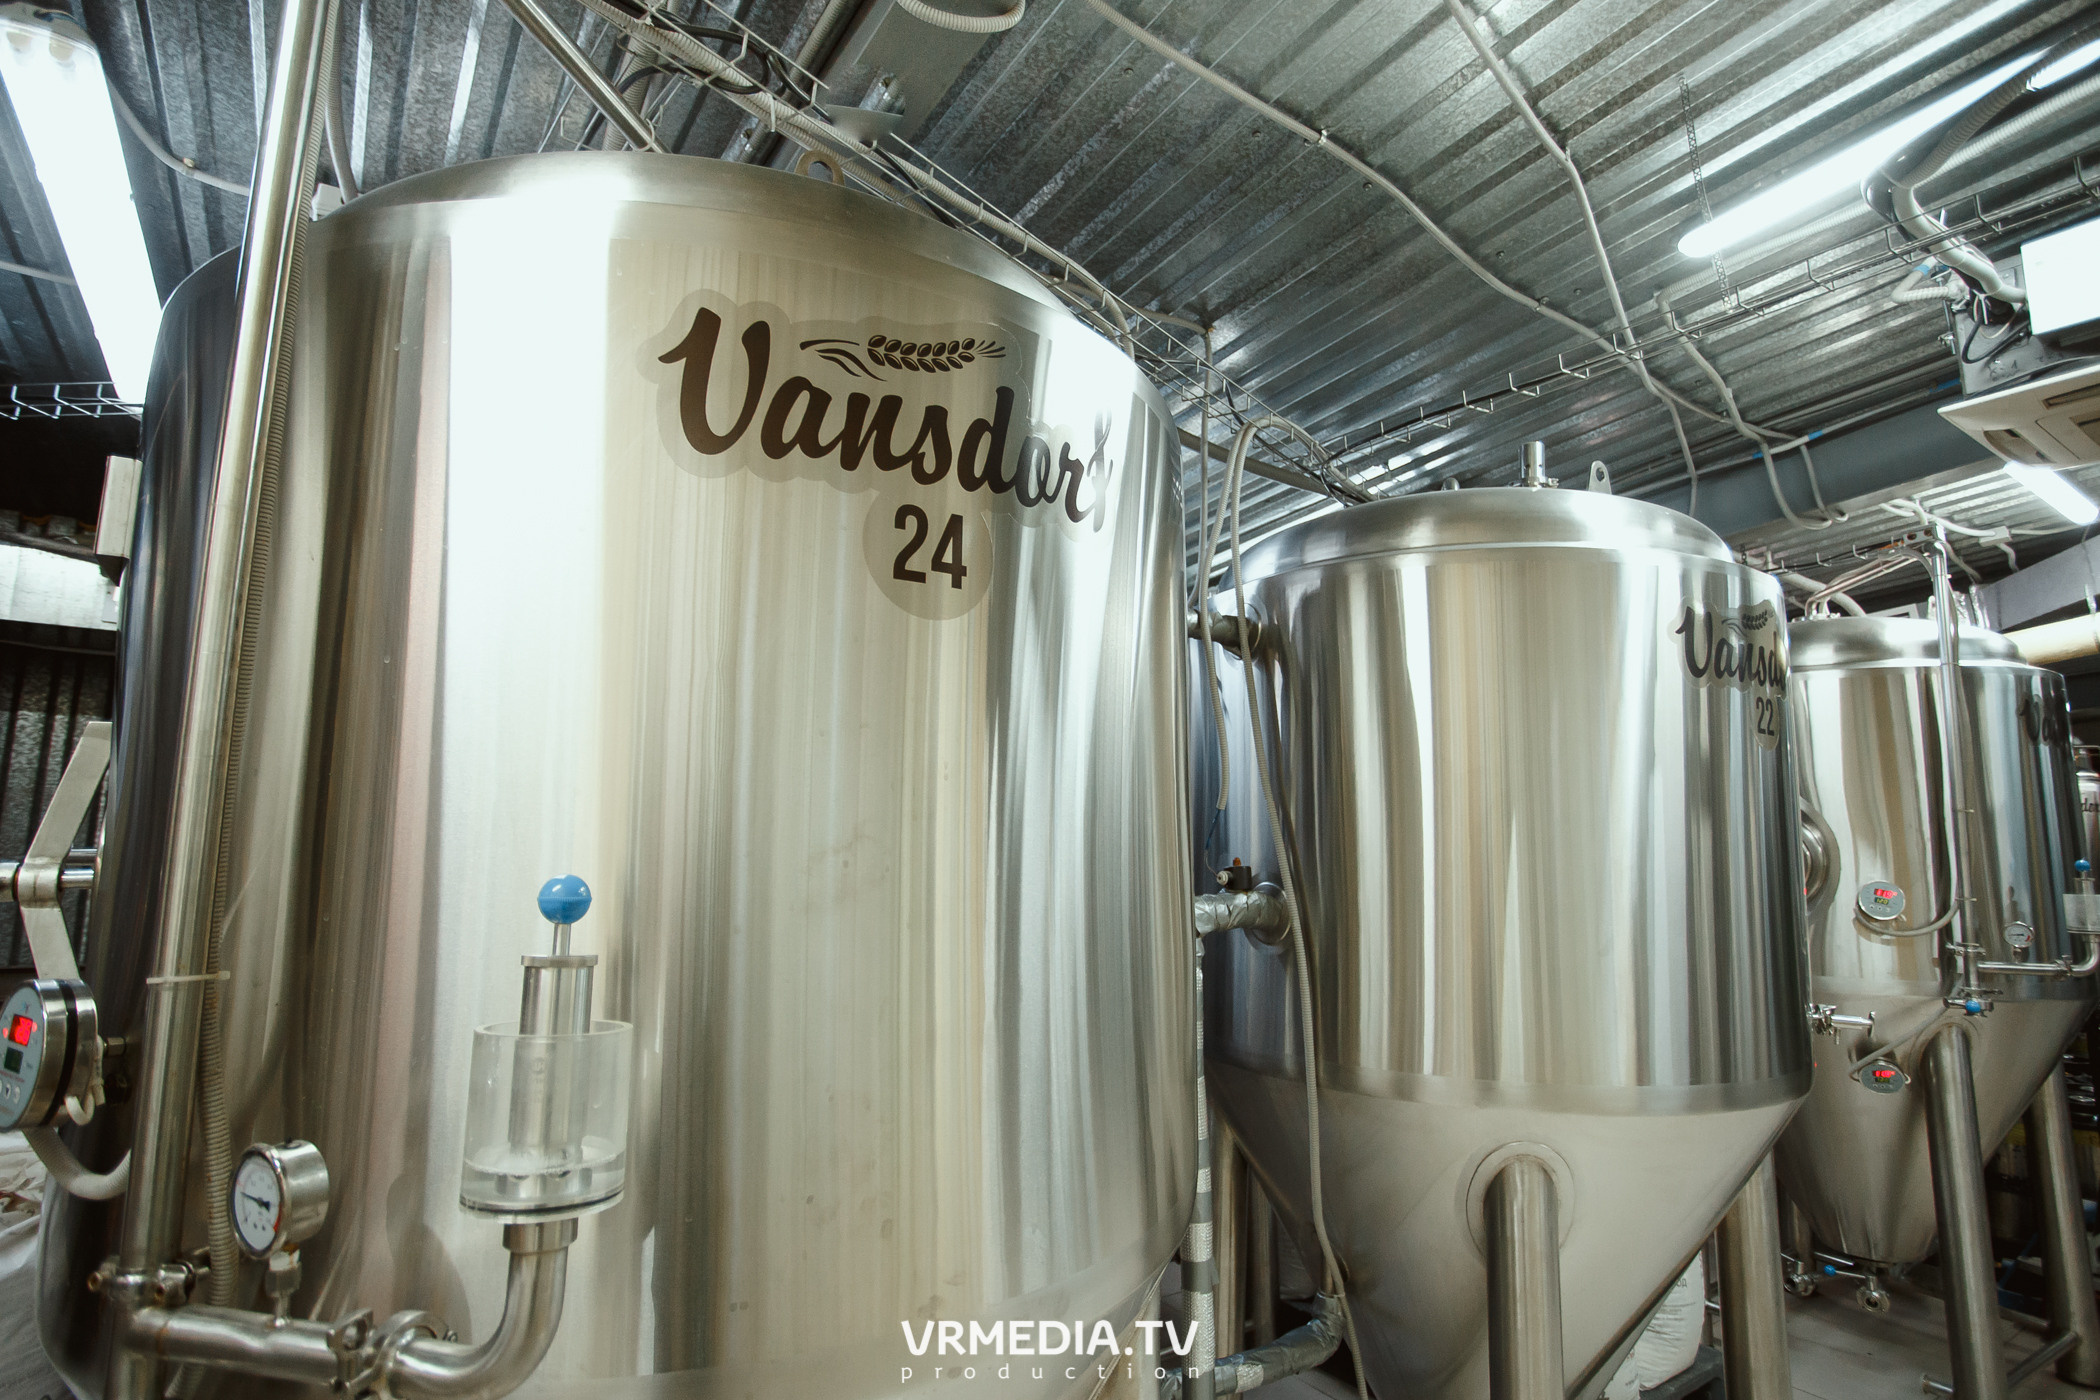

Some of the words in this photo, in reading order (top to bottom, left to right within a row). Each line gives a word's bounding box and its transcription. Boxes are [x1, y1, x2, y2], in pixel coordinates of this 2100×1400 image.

[658, 306, 1114, 534] Vansdorf
[893, 503, 968, 590] 24
[1756, 696, 1775, 736] 22
